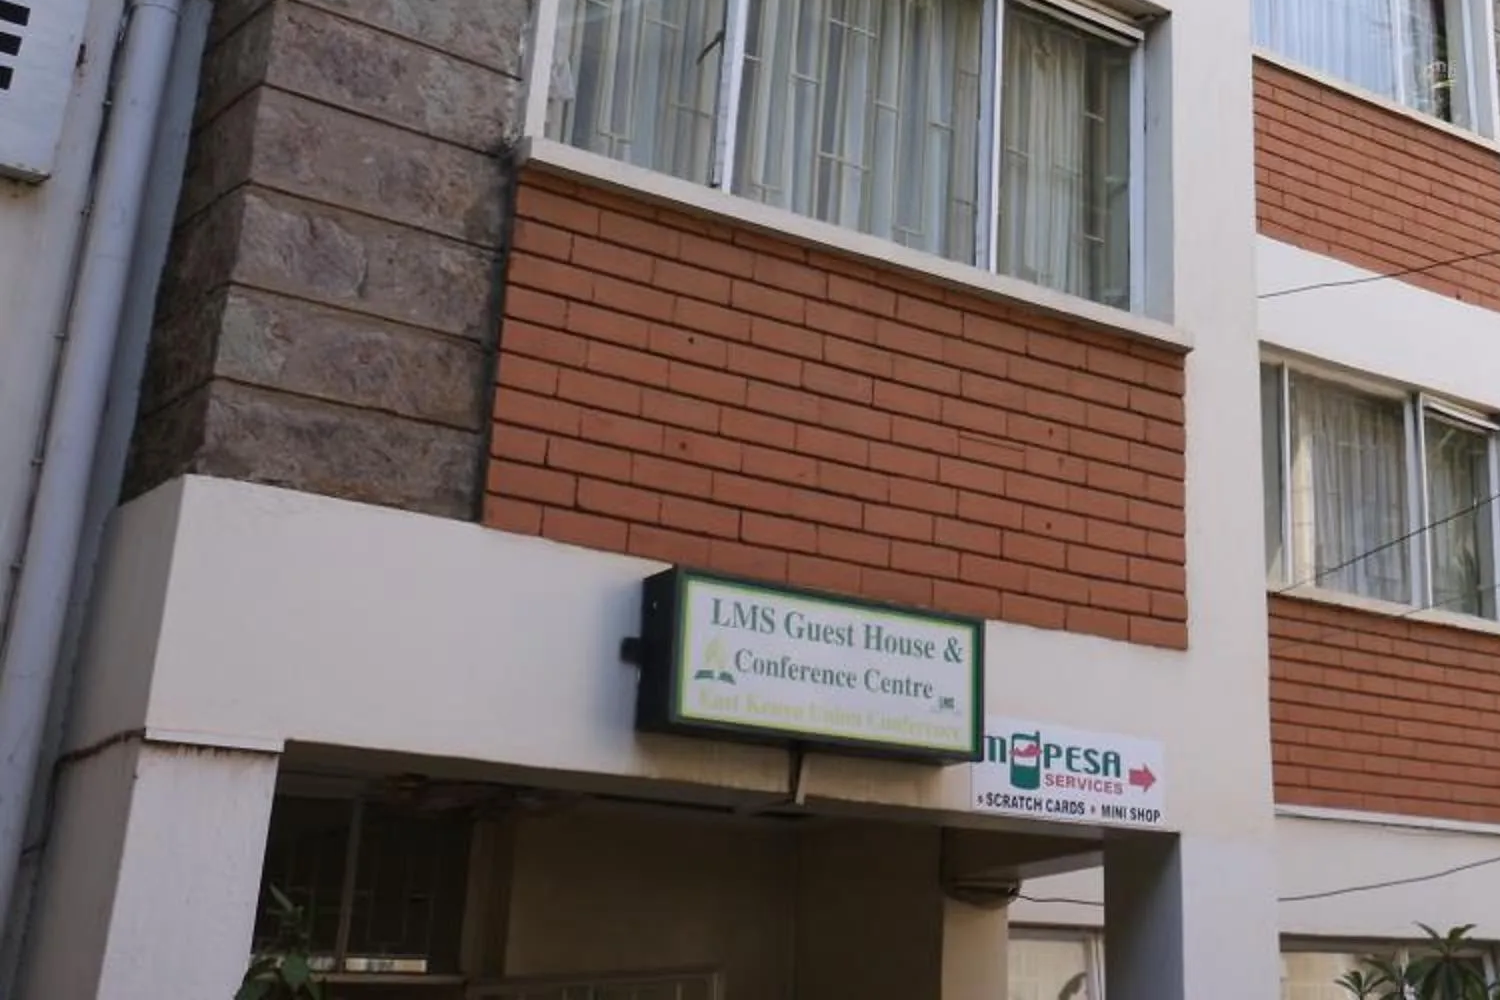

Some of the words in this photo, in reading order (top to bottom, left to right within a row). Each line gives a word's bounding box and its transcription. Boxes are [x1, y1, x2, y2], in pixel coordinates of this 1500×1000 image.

[711, 597, 775, 635] LMS
[784, 610, 854, 648] Guest
[863, 623, 935, 659] House
[943, 635, 963, 664] &
[735, 648, 857, 690] Conference
[863, 668, 933, 699] Centre
[1044, 773, 1124, 795] SERVICES
[986, 791, 1042, 812] SCRATCH
[1045, 799, 1085, 815] CARDS
[1101, 803, 1127, 820] MINI
[1130, 807, 1161, 823] SHOP
